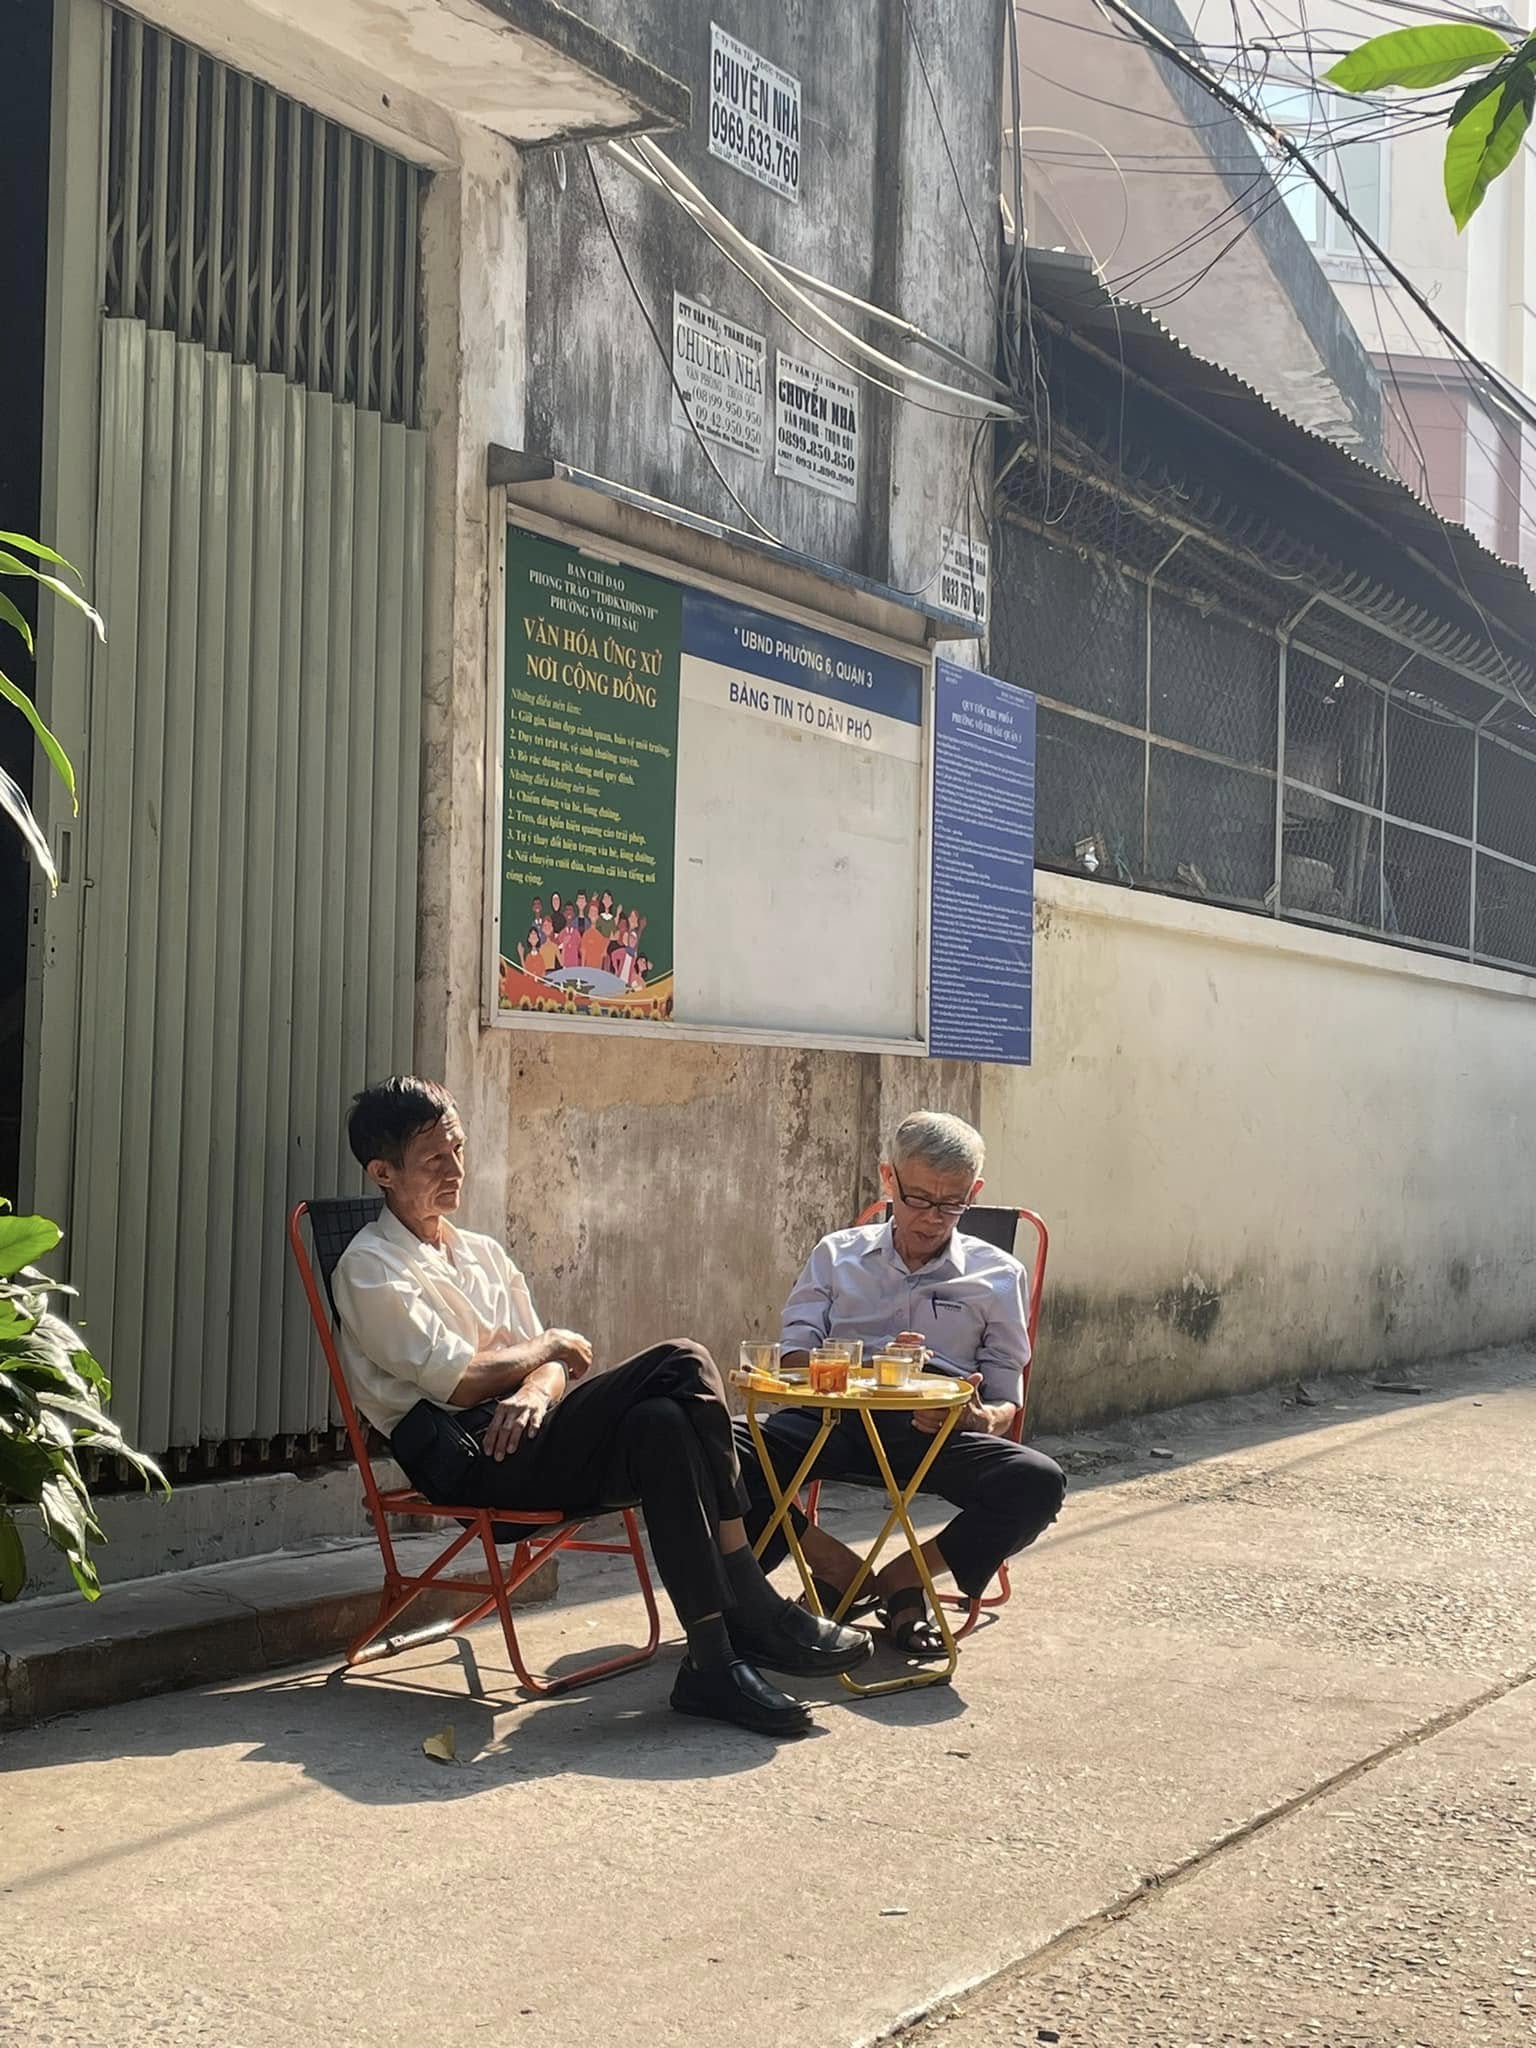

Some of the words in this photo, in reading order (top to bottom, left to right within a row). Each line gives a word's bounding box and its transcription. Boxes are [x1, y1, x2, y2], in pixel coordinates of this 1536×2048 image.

[714, 48, 768, 124] CHUYỂN
[773, 87, 799, 143] NHÀ
[712, 101, 798, 187] 0969.633.760
[679, 302, 692, 318] CTY
[677, 324, 731, 380] CHUYỂN
[735, 350, 763, 395] NHÀ
[780, 358, 793, 370] CTY
[778, 378, 828, 422] CHUYỂN
[832, 402, 856, 434] NHÀ
[778, 426, 854, 472] 0899.850.850
[529, 569, 562, 590] PHONG
[564, 579, 590, 600] TRÀO
[568, 562, 586, 579] BAN
[588, 569, 604, 586] CHỈ
[606, 576, 624, 592] ĐẠO
[550, 595, 589, 618] PHƯỜNG
[590, 606, 604, 623] VÕ
[606, 612, 621, 630] THỊ
[622, 617, 640, 634] SÁU
[523, 616, 560, 648] VĂN
[563, 628, 600, 659] HÓA
[604, 636, 636, 670] ỨNG
[640, 649, 663, 677] XỬ
[740, 628, 773, 656] UBND
[776, 640, 823, 671] PHƯỜNG
[824, 660, 834, 678] 6,
[836, 662, 866, 688] QUẬN
[866, 672, 873, 688] 3
[526, 654, 558, 683] NƠI
[562, 661, 608, 696] CỘNG
[612, 672, 656, 709] ĐỒNG
[510, 708, 518, 720] 1.
[730, 679, 769, 712] BẢNG
[773, 695, 794, 720] TIN
[818, 706, 844, 732] DÂN
[510, 728, 516, 740] 2.
[518, 730, 532, 746] Duy
[510, 748, 516, 760] 3.
[509, 790, 515, 801] 1.
[508, 809, 514, 821] 2.
[508, 829, 514, 840] 3.
[507, 849, 514, 861] 4.
